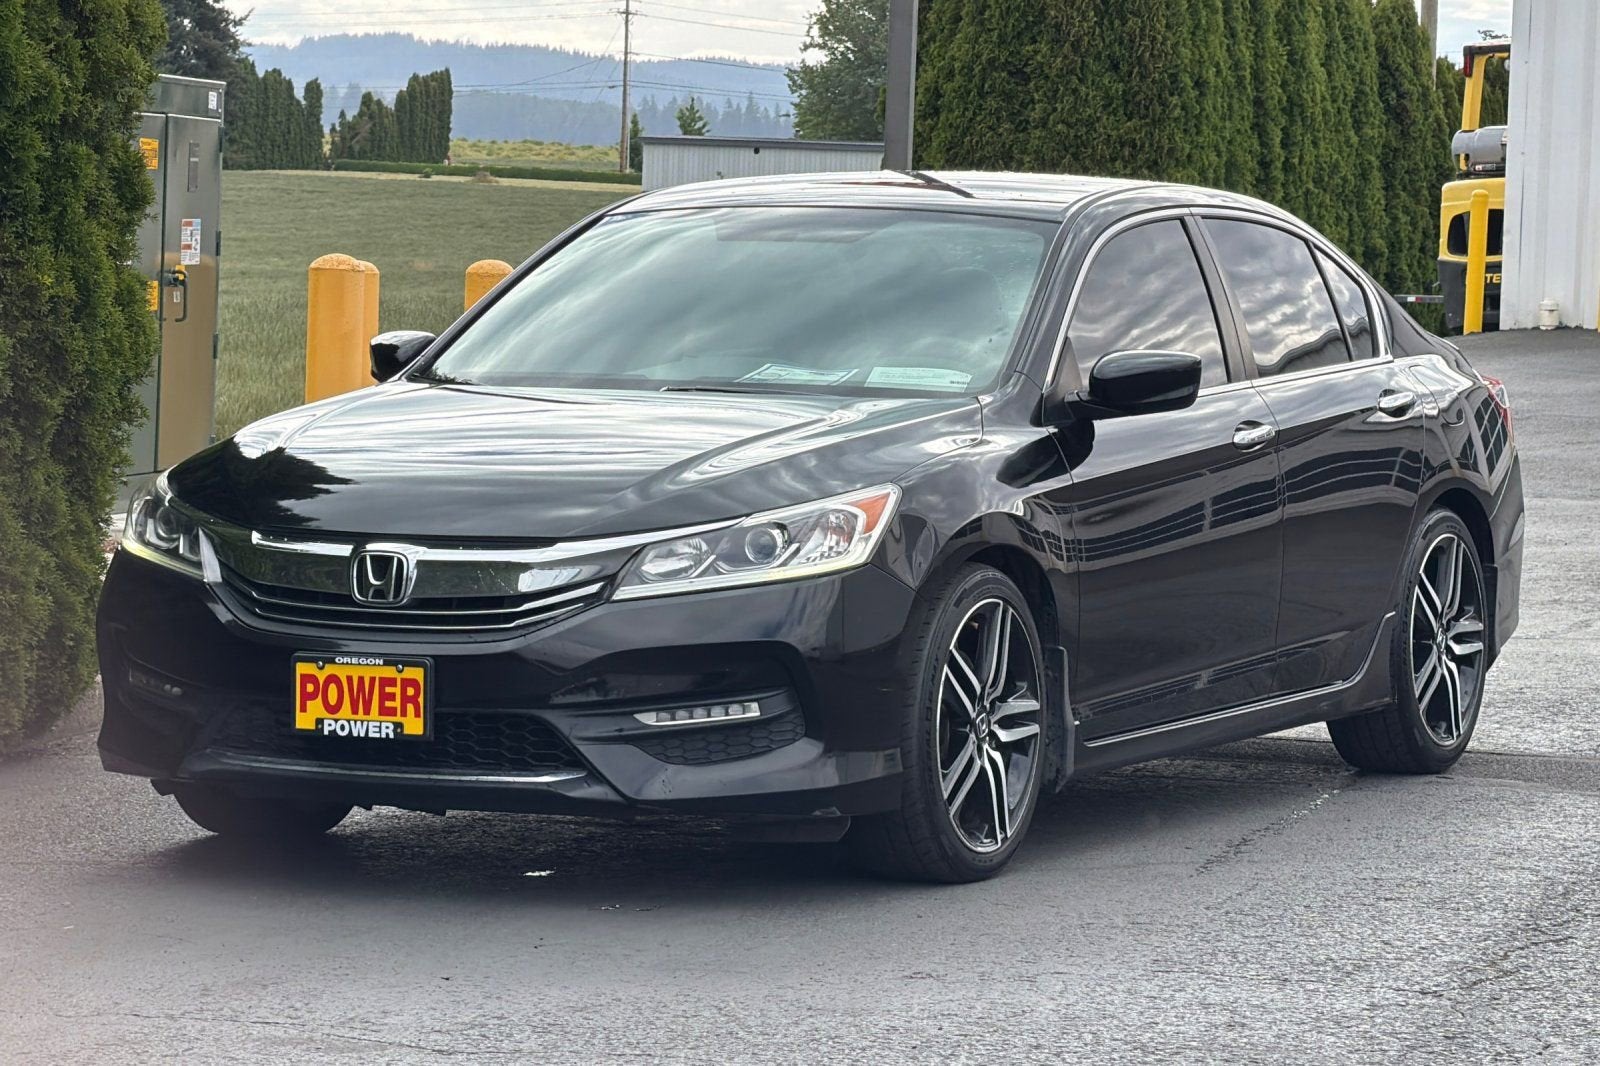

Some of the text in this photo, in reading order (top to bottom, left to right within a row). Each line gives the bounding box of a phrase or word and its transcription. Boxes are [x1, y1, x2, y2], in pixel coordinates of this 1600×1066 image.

[335, 656, 384, 665] OREGON
[299, 673, 422, 719] POWER
[323, 719, 395, 739] POWER
